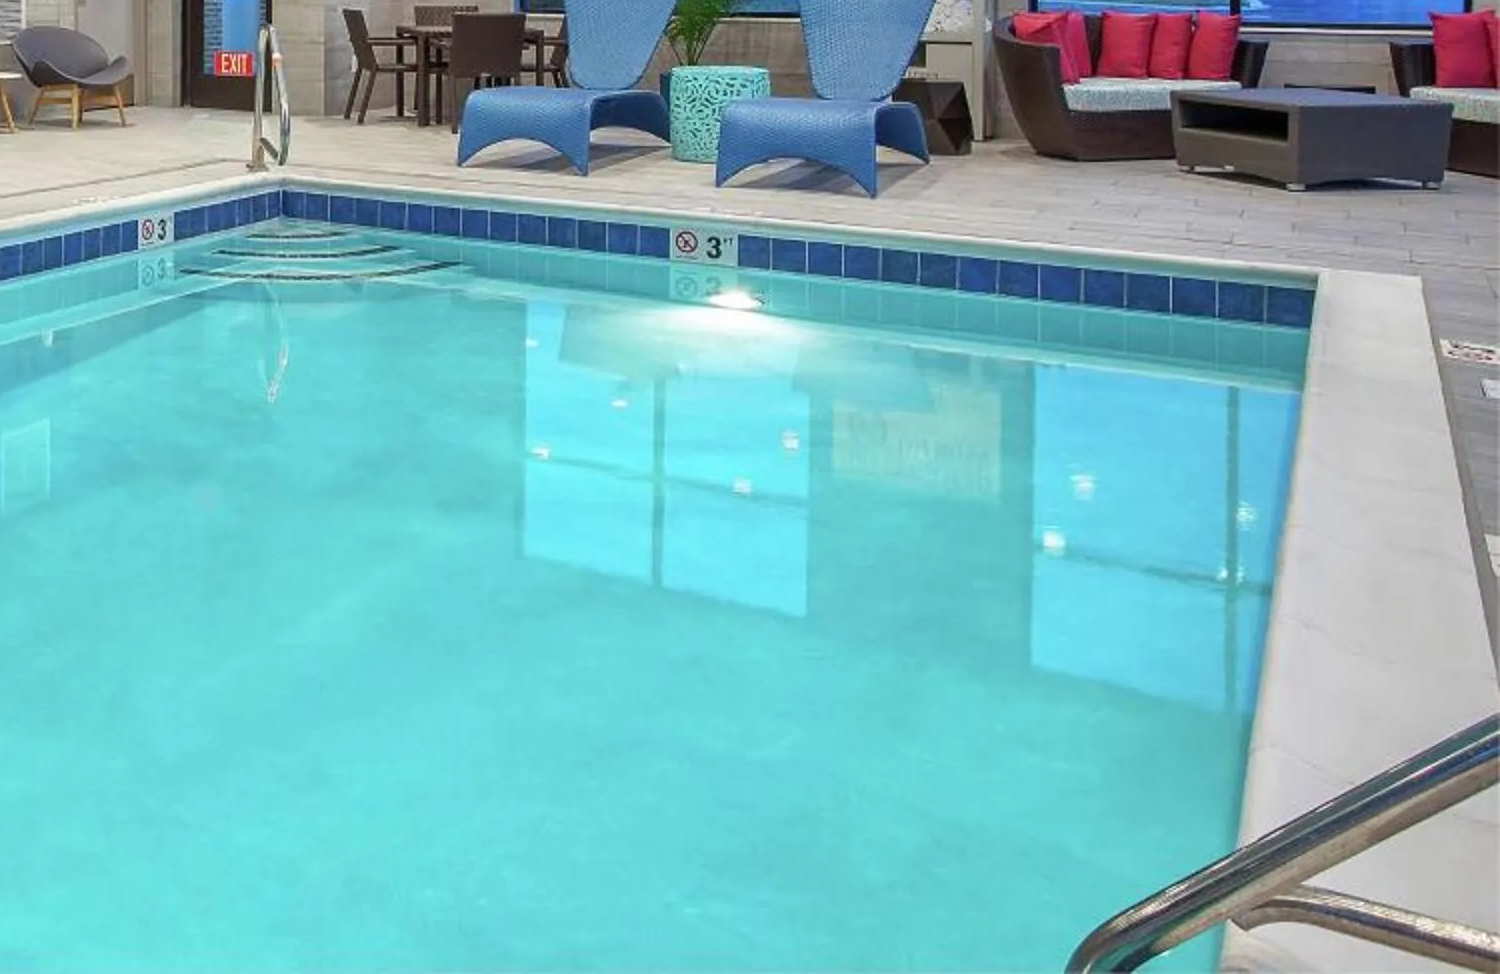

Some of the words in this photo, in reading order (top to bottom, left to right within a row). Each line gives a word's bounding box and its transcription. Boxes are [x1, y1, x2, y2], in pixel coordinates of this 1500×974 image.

[221, 53, 248, 74] EXIT
[157, 218, 167, 240] 3
[706, 236, 722, 259] 3
